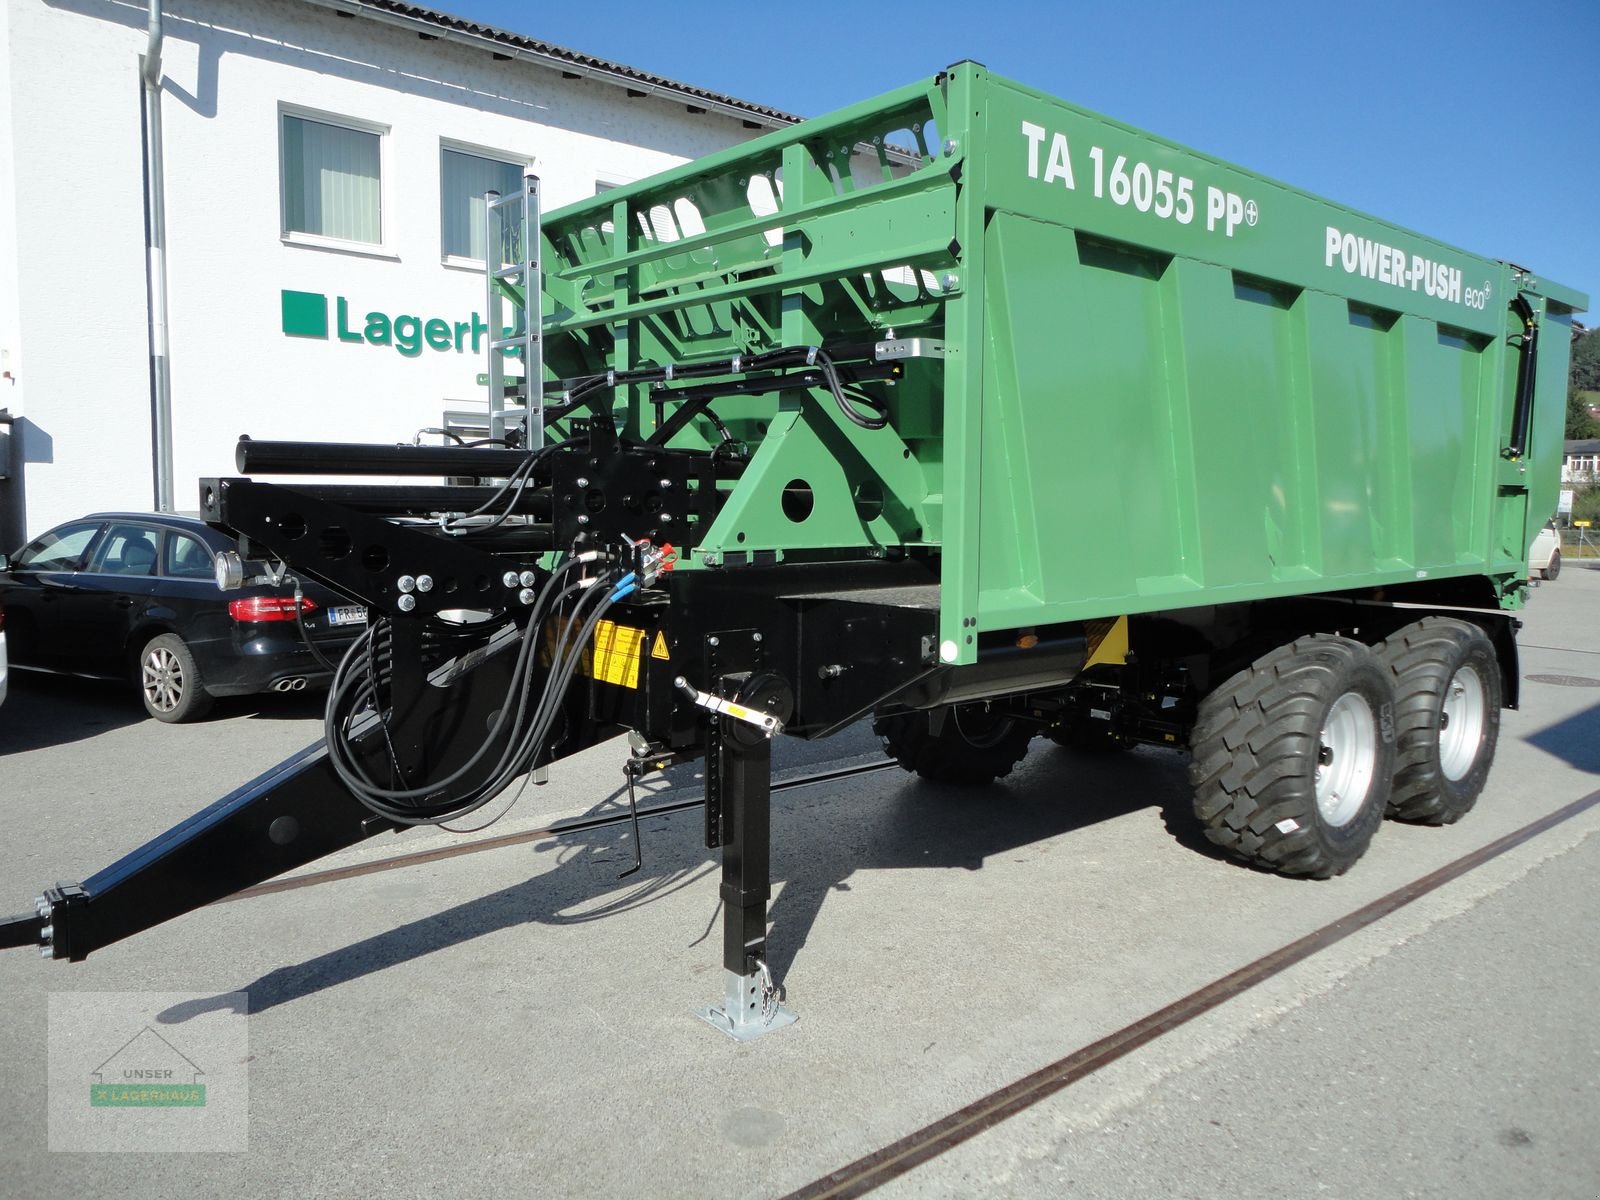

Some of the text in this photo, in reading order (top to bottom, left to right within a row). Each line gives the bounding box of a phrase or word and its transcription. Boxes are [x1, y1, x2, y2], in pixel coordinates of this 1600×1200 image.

[1022, 120, 1075, 190] TA
[1089, 146, 1194, 225] 16055
[1325, 226, 1462, 304] POWER-PUSH
